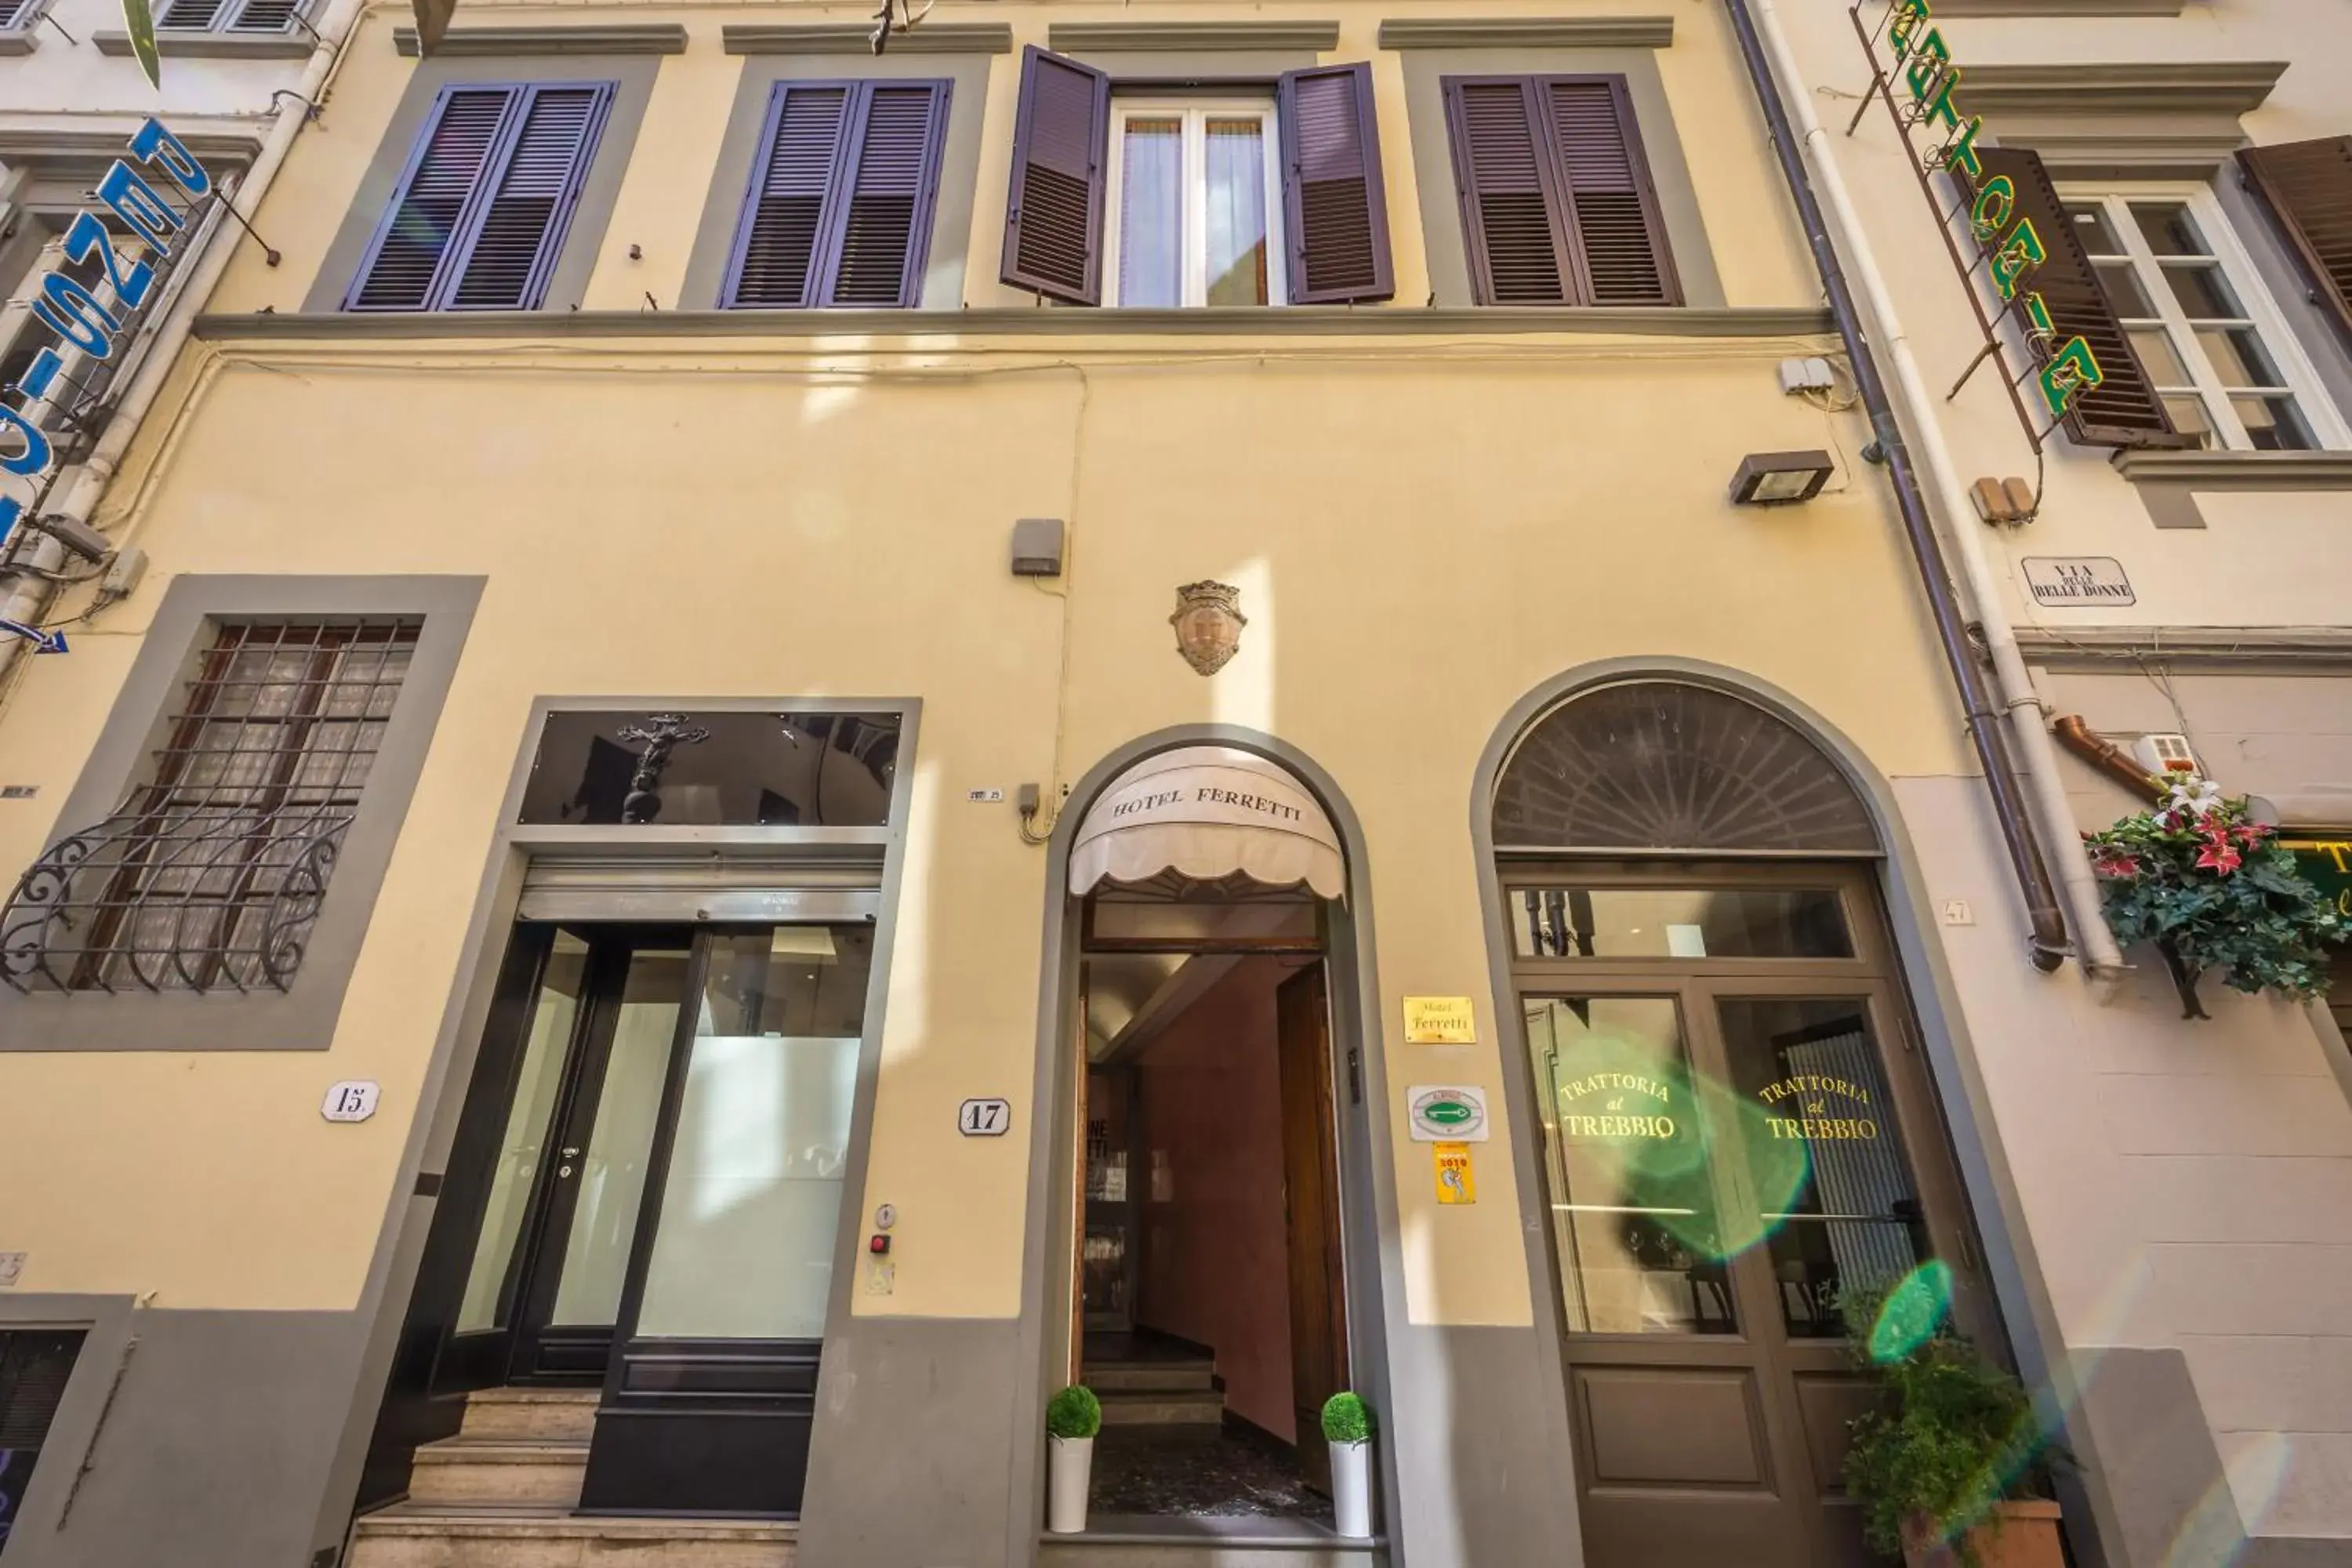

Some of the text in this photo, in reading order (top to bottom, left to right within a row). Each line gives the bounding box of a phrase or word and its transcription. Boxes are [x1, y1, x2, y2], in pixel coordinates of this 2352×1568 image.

[0, 115, 212, 547] PENSIO
[2055, 564, 2092, 576] VIA
[2034, 584, 2131, 597] BELLE DONNE
[1113, 787, 1301, 822] HOTEL FERRETTI
[1425, 1003, 1452, 1013] Hotel
[1413, 1017, 1467, 1029] Ferretti
[1560, 1073, 1669, 1103] TRATTORIA
[1759, 1074, 1869, 1105] TRATTORIA
[336, 1087, 365, 1112] 15
[1606, 1095, 1624, 1111] al
[1807, 1098, 1825, 1114] al
[966, 1105, 1001, 1130] 17
[1563, 1116, 1675, 1139] TREBBIO
[1765, 1118, 1878, 1140] TREBBIO
